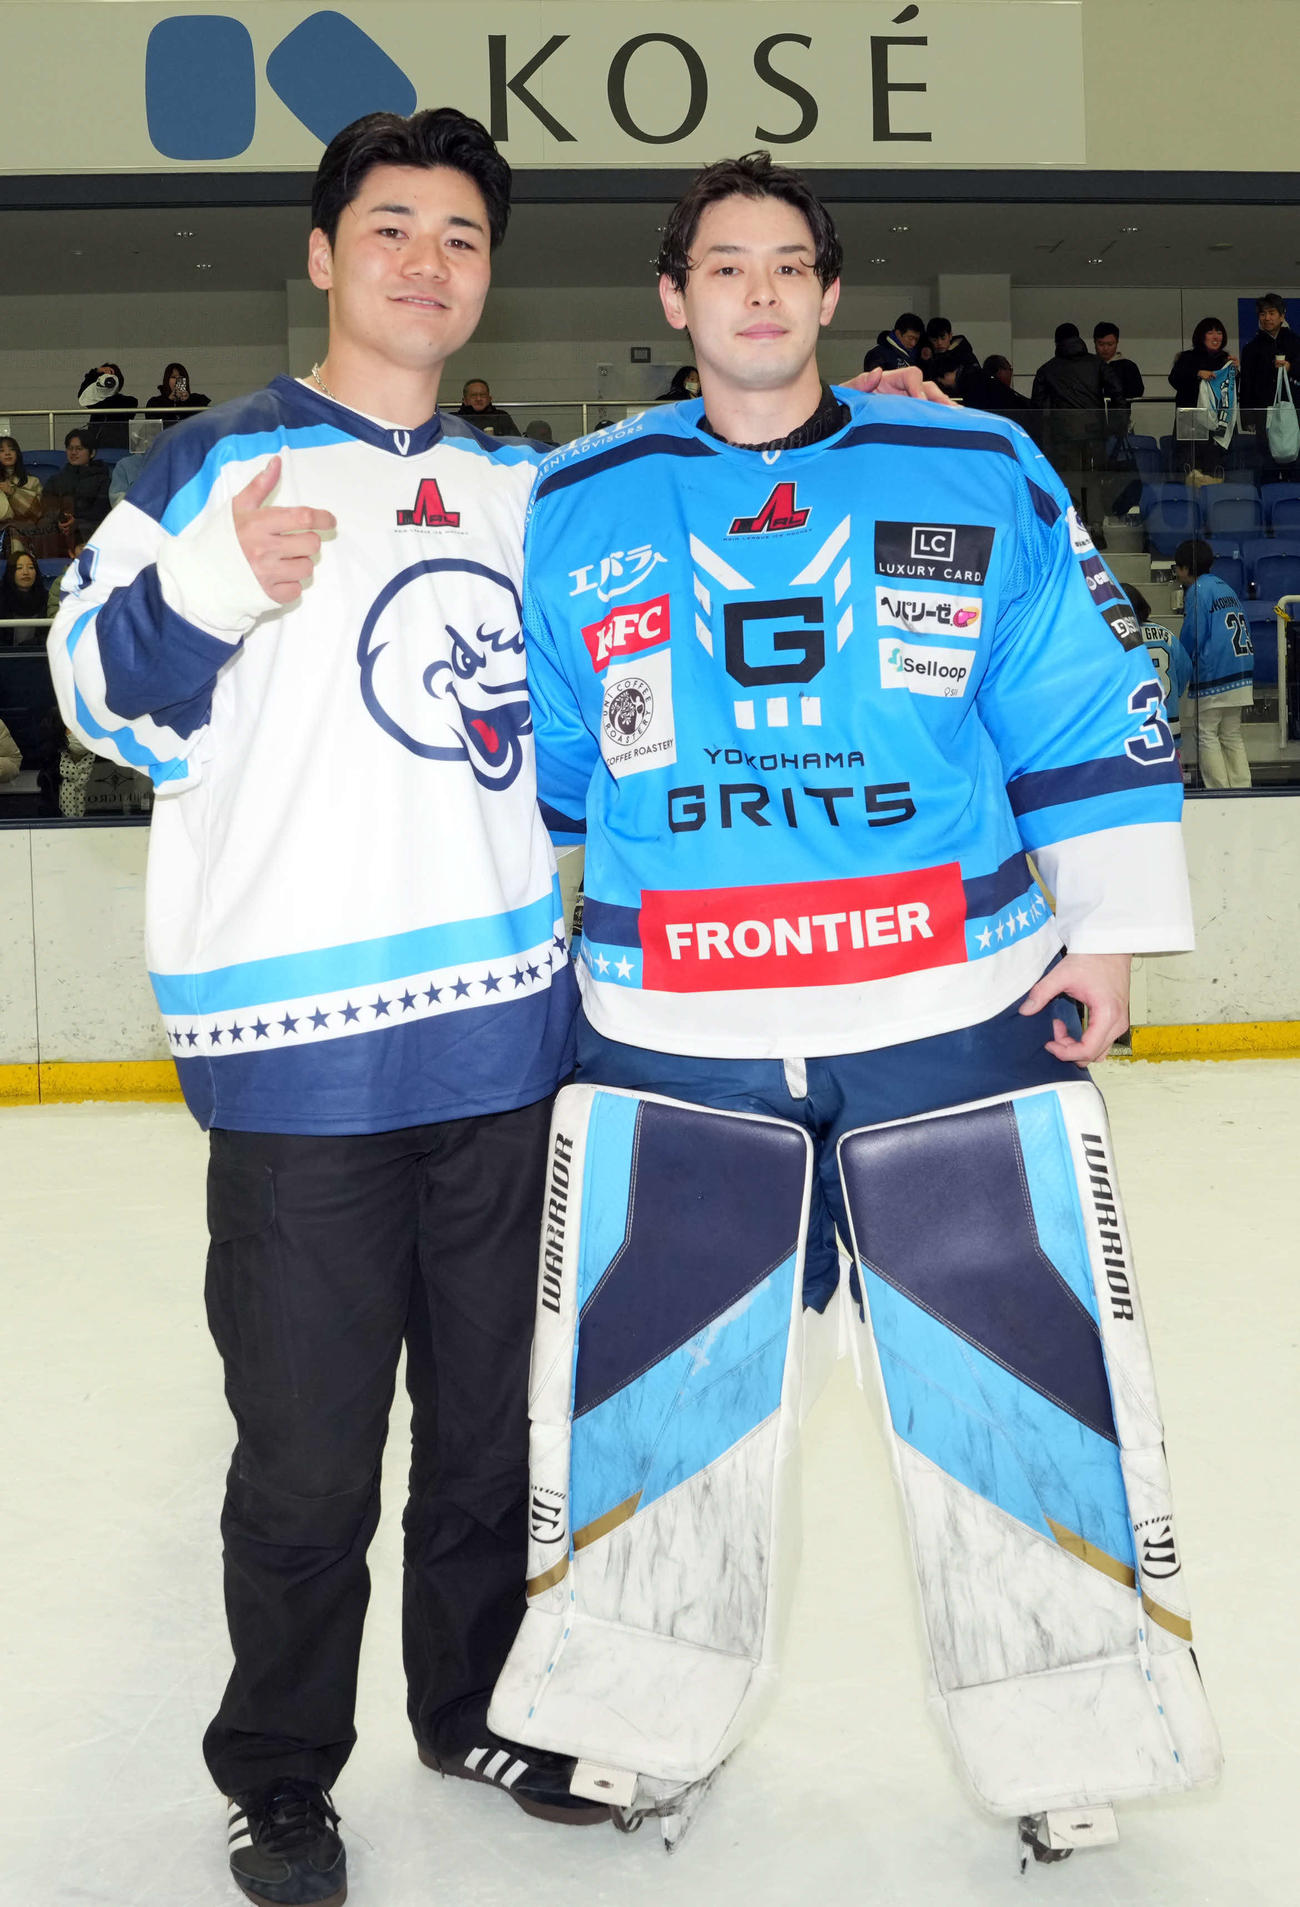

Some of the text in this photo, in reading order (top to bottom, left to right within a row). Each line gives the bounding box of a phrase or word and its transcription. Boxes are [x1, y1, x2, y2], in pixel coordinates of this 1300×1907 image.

[488, 4, 932, 144] KOSÉ
[571, 424, 643, 457] ADVISORS
[919, 533, 947, 553] LC
[568, 544, 668, 602] エバラ
[878, 562, 982, 582] LUXURY CARD
[880, 596, 951, 626] ヘパリーゼ
[596, 605, 662, 662] KFC
[723, 596, 826, 688] G
[904, 657, 967, 683] Selloop
[616, 680, 651, 703] COFFEE
[605, 710, 651, 744] ROASTERY
[633, 739, 674, 757] ROASTERY
[703, 748, 865, 771] YOKOHAMA
[667, 781, 917, 834] GRITS
[664, 901, 934, 961] FRONTIER
[541, 1133, 573, 1315] WARRIOR
[1081, 1133, 1134, 1321] WARRIOR
